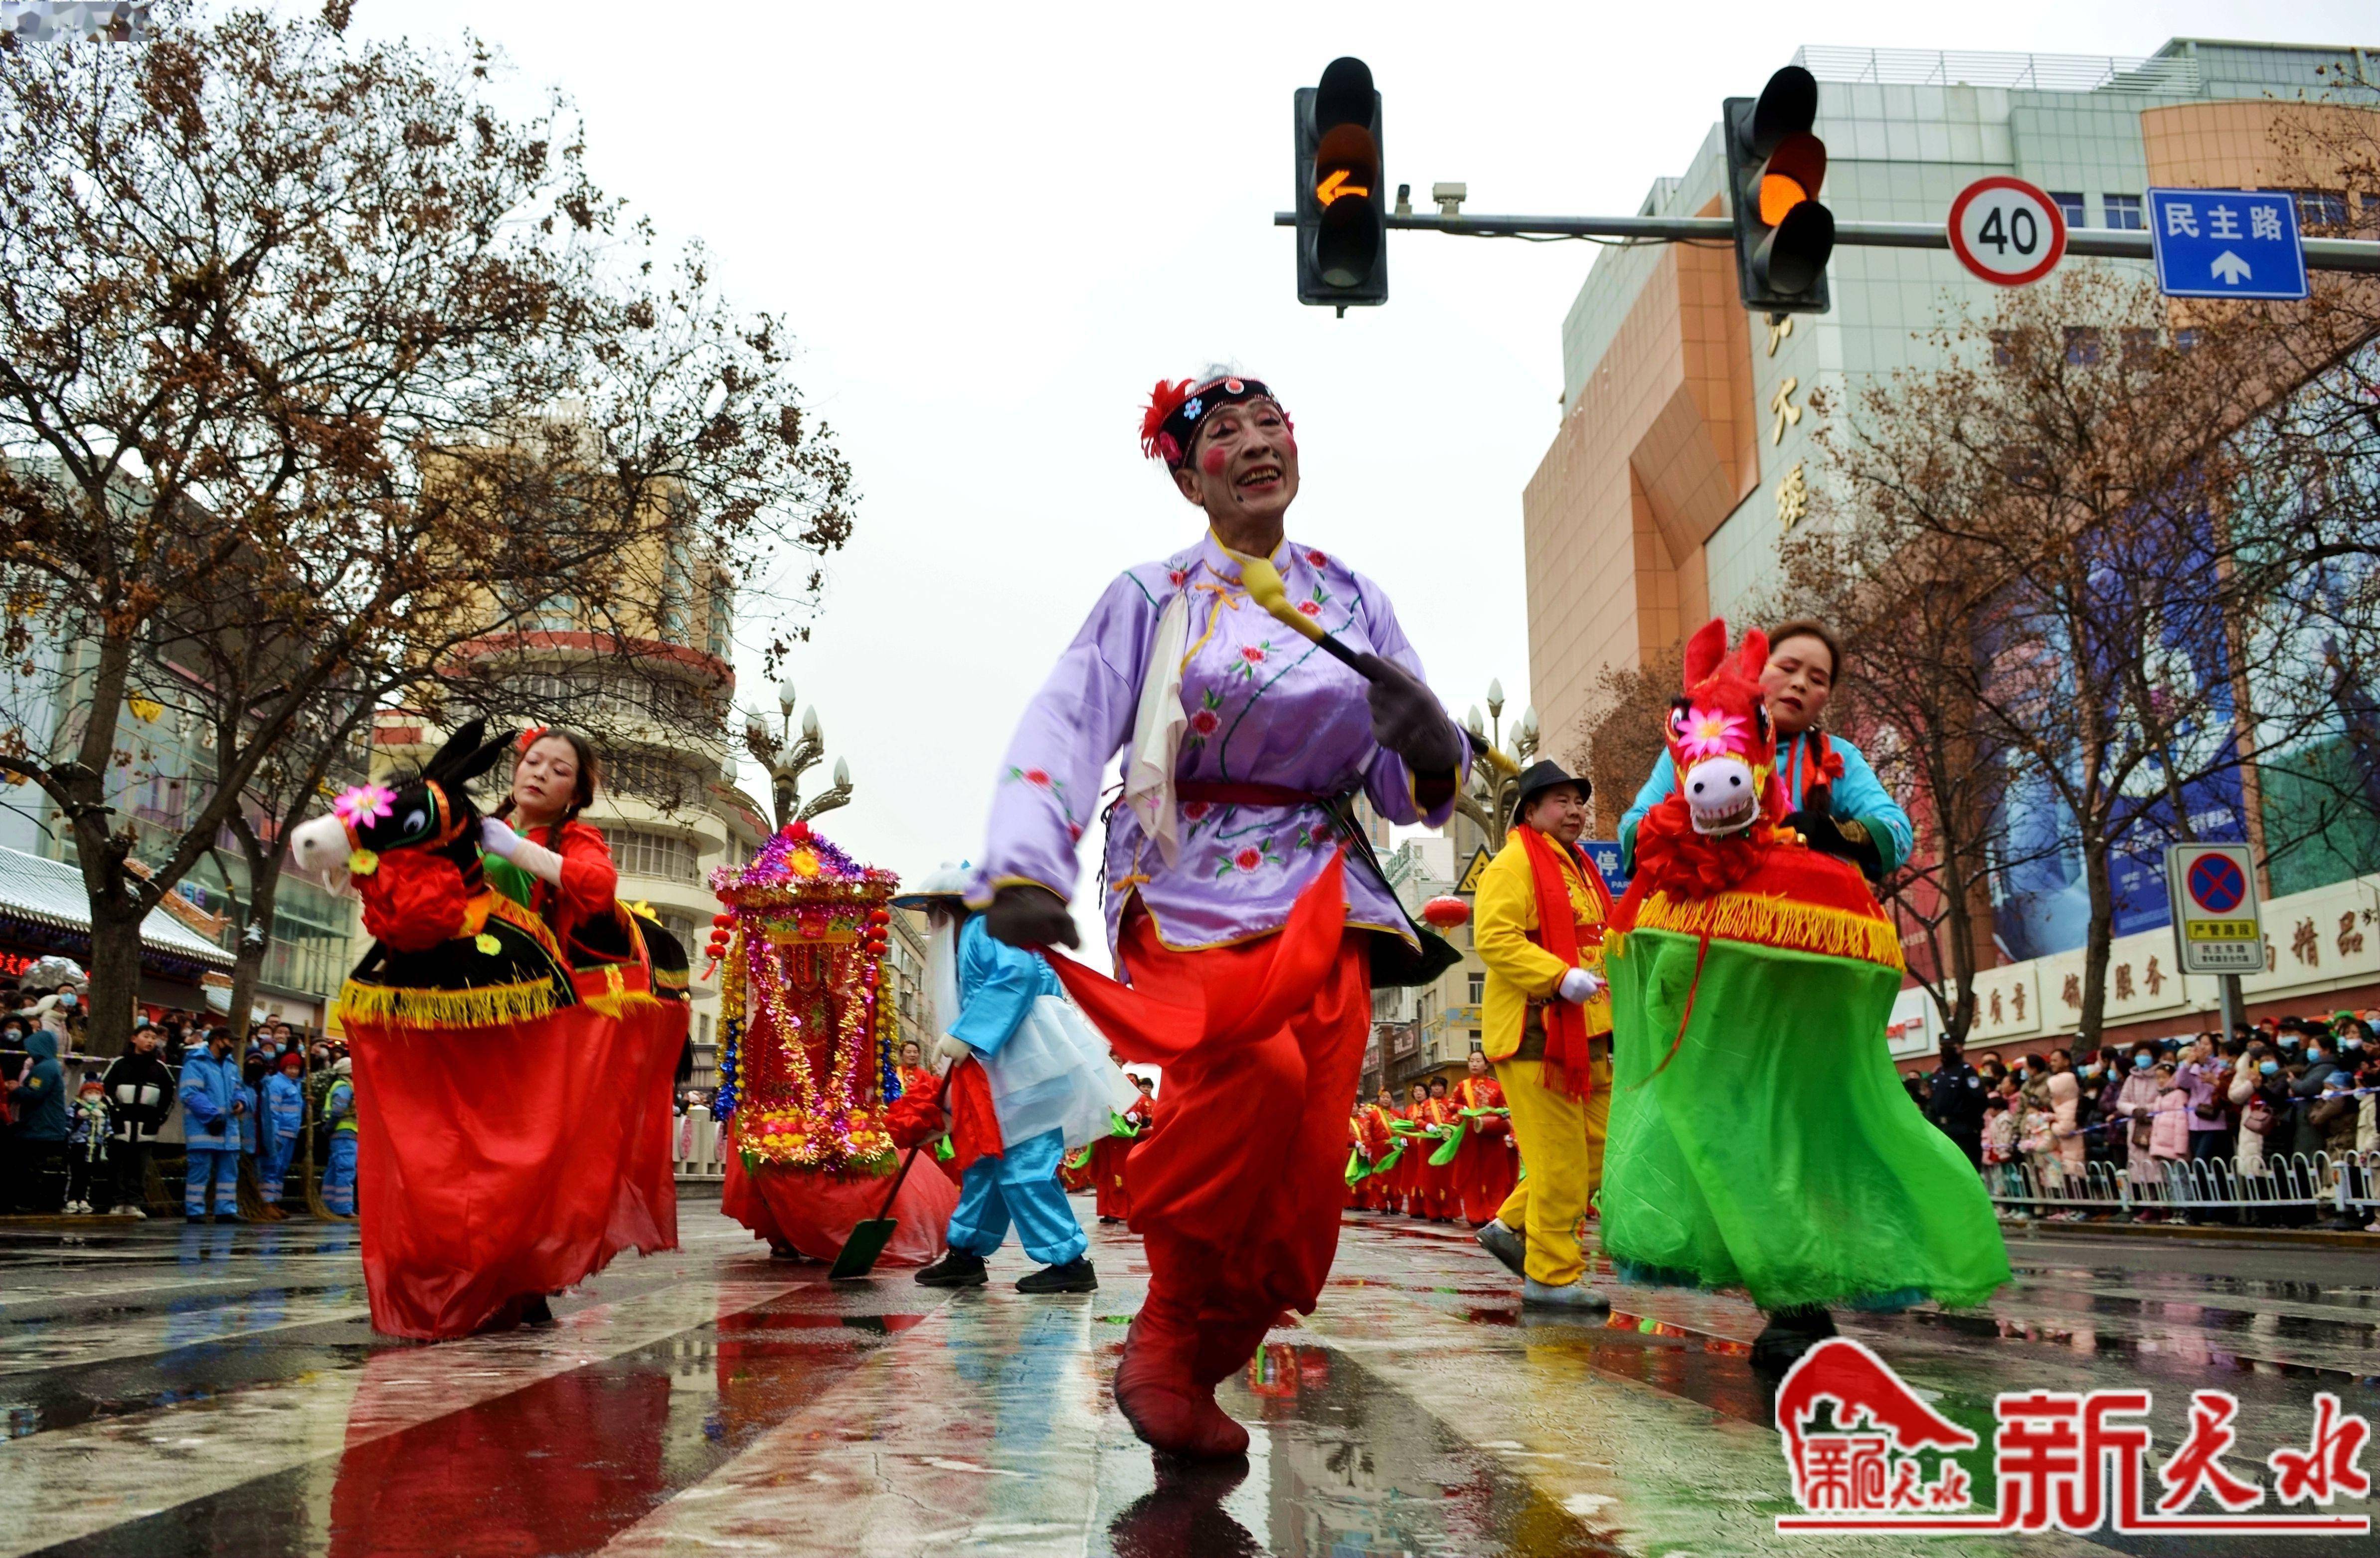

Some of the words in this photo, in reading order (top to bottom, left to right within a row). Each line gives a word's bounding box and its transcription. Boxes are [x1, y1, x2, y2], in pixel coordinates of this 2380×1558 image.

[1978, 206, 2038, 256] 40
[2165, 202, 2283, 241] 民主路
[1596, 850, 1618, 876] 停
[2195, 923, 2249, 936] 严管路段
